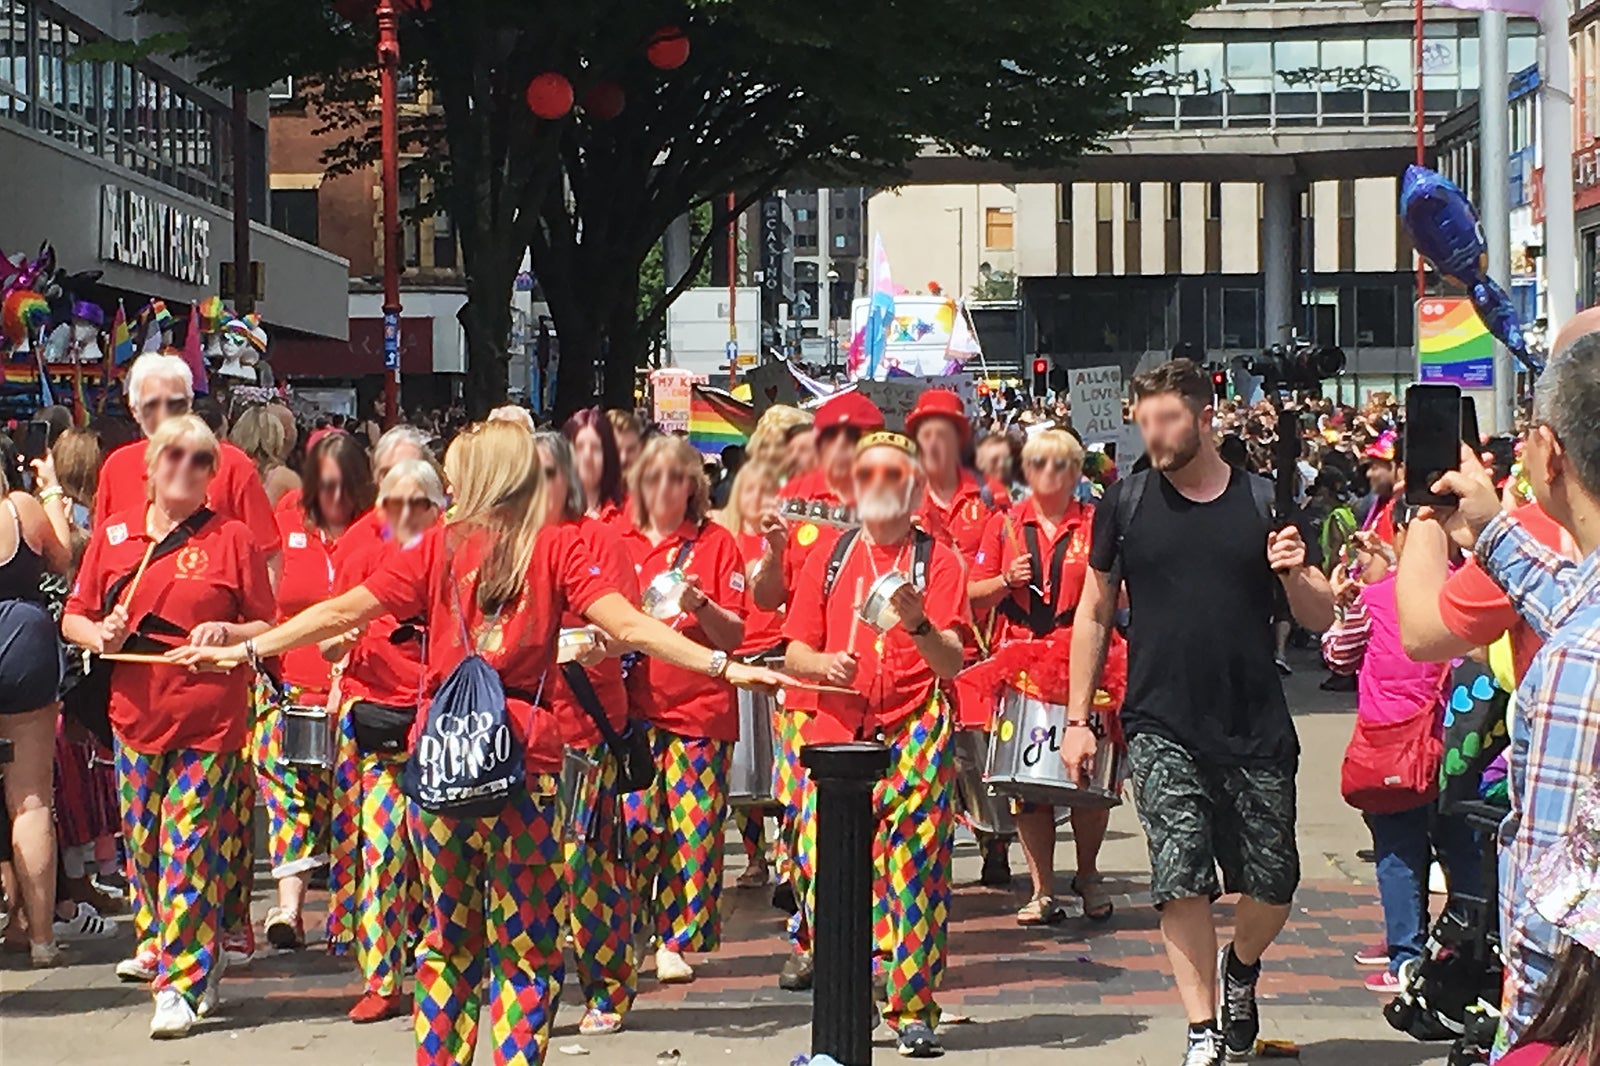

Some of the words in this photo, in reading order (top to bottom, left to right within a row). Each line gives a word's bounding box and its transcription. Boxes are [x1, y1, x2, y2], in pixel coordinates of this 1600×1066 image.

[102, 184, 167, 273] ALBANY
[1081, 388, 1121, 402] LOVES
[1089, 403, 1113, 417] US
[1086, 418, 1117, 434] ALL
